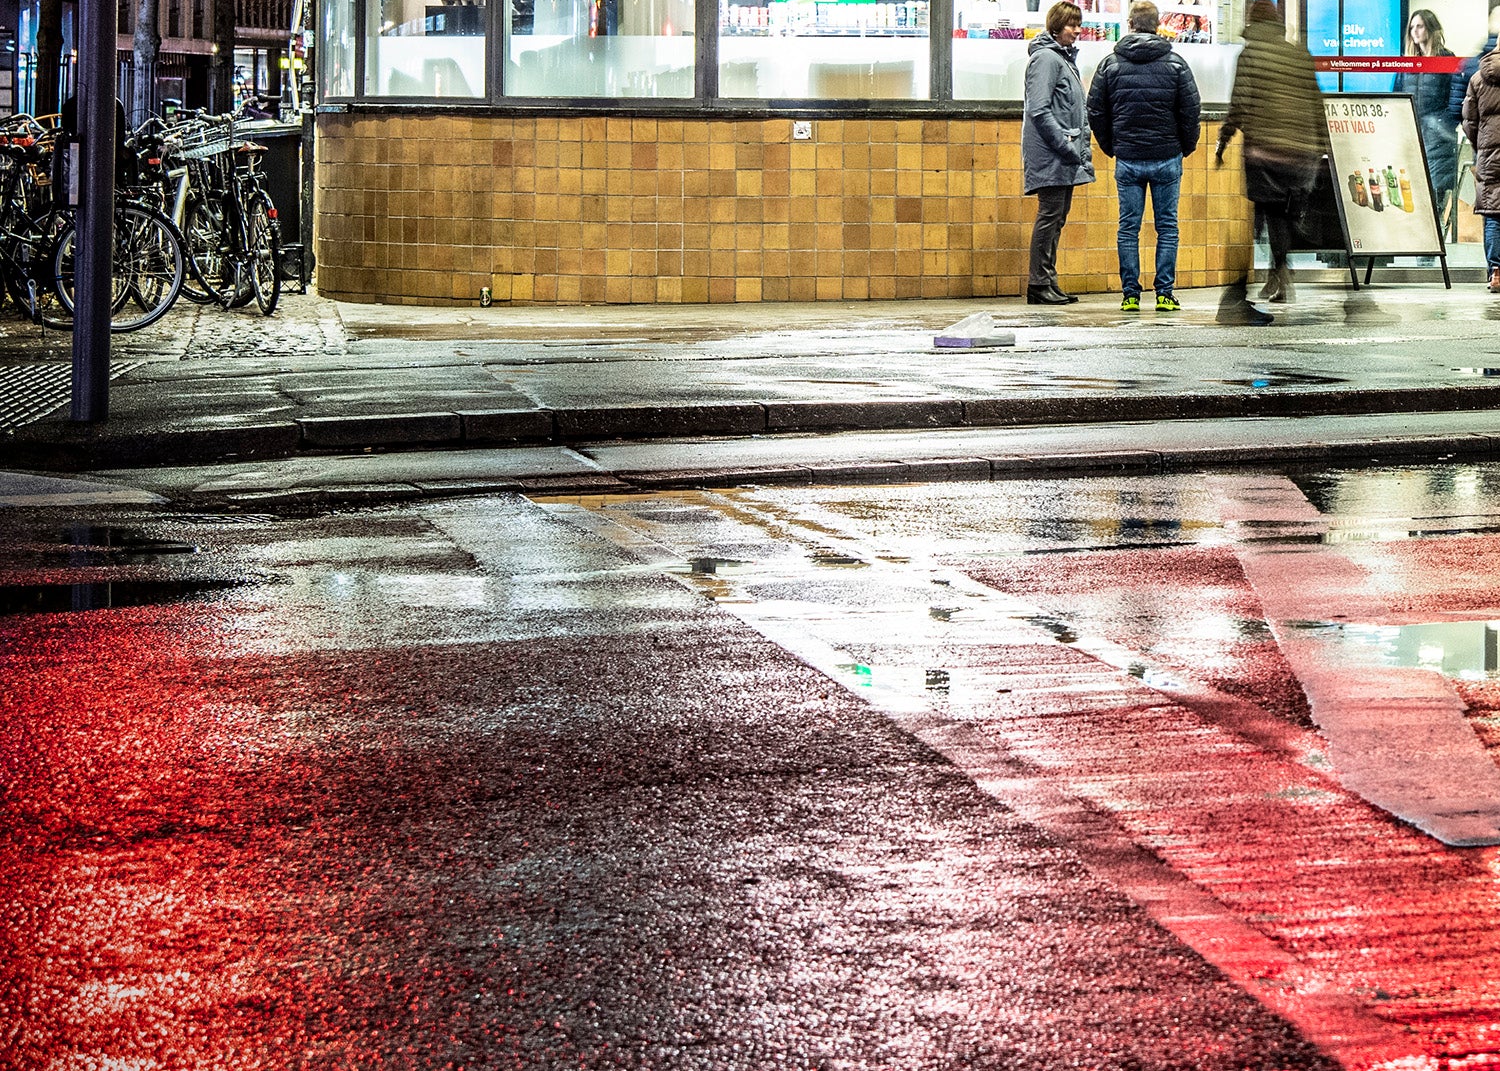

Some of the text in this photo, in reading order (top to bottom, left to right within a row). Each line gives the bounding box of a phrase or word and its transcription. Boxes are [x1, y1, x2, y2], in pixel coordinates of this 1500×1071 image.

[1343, 24, 1366, 35] Bliv
[1330, 60, 1414, 69] Velkommen på stationen
[1343, 104, 1349, 117] 3
[1351, 104, 1369, 118] FOR
[1328, 120, 1376, 134] FRIT VALG
